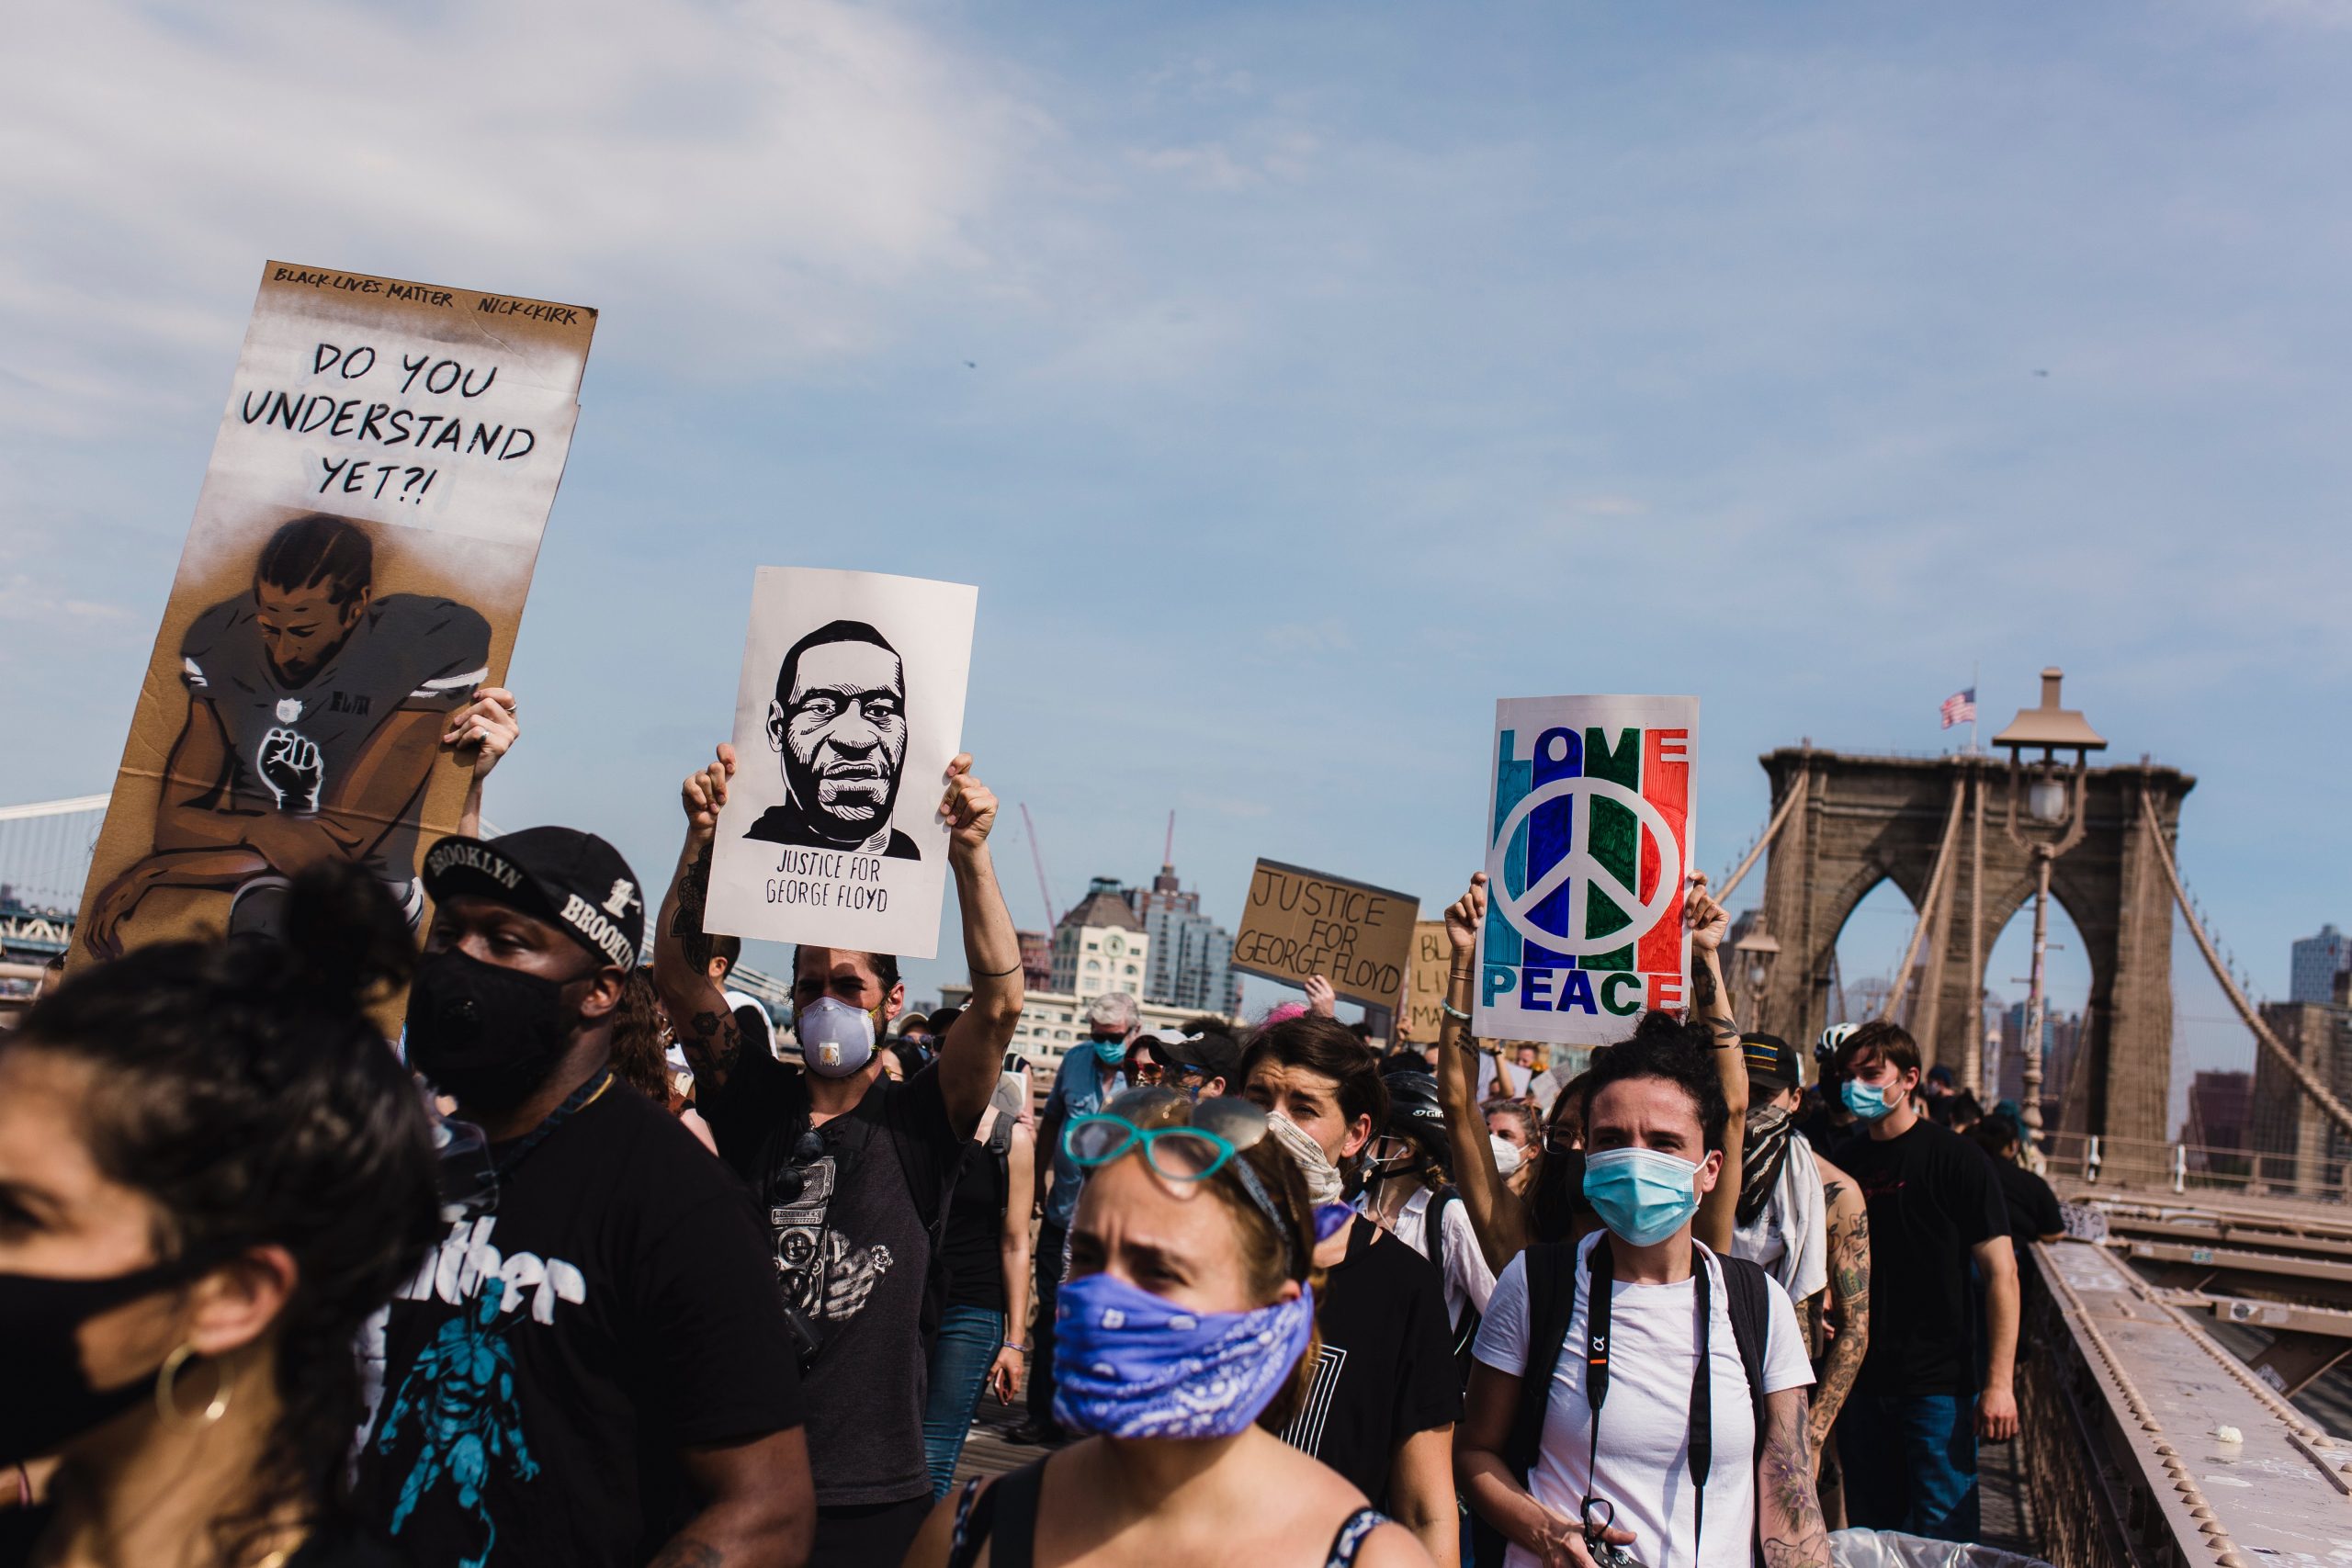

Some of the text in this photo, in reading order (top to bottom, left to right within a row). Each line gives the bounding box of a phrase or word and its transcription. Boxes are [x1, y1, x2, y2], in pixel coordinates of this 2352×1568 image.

[313, 343, 499, 399] DO YOU
[243, 390, 536, 461] UNDERSTAND
[318, 457, 438, 505] YET?!
[427, 844, 523, 890] BROOKLYN
[776, 849, 881, 883] JUSTICE FOR
[766, 878, 888, 913] GEORGE FLOYD
[1252, 868, 1387, 927] JUSTICE
[1234, 929, 1401, 995] GEORGE FLOYD
[1308, 919, 1359, 956] FOR
[1482, 964, 1683, 1017] PEACE
